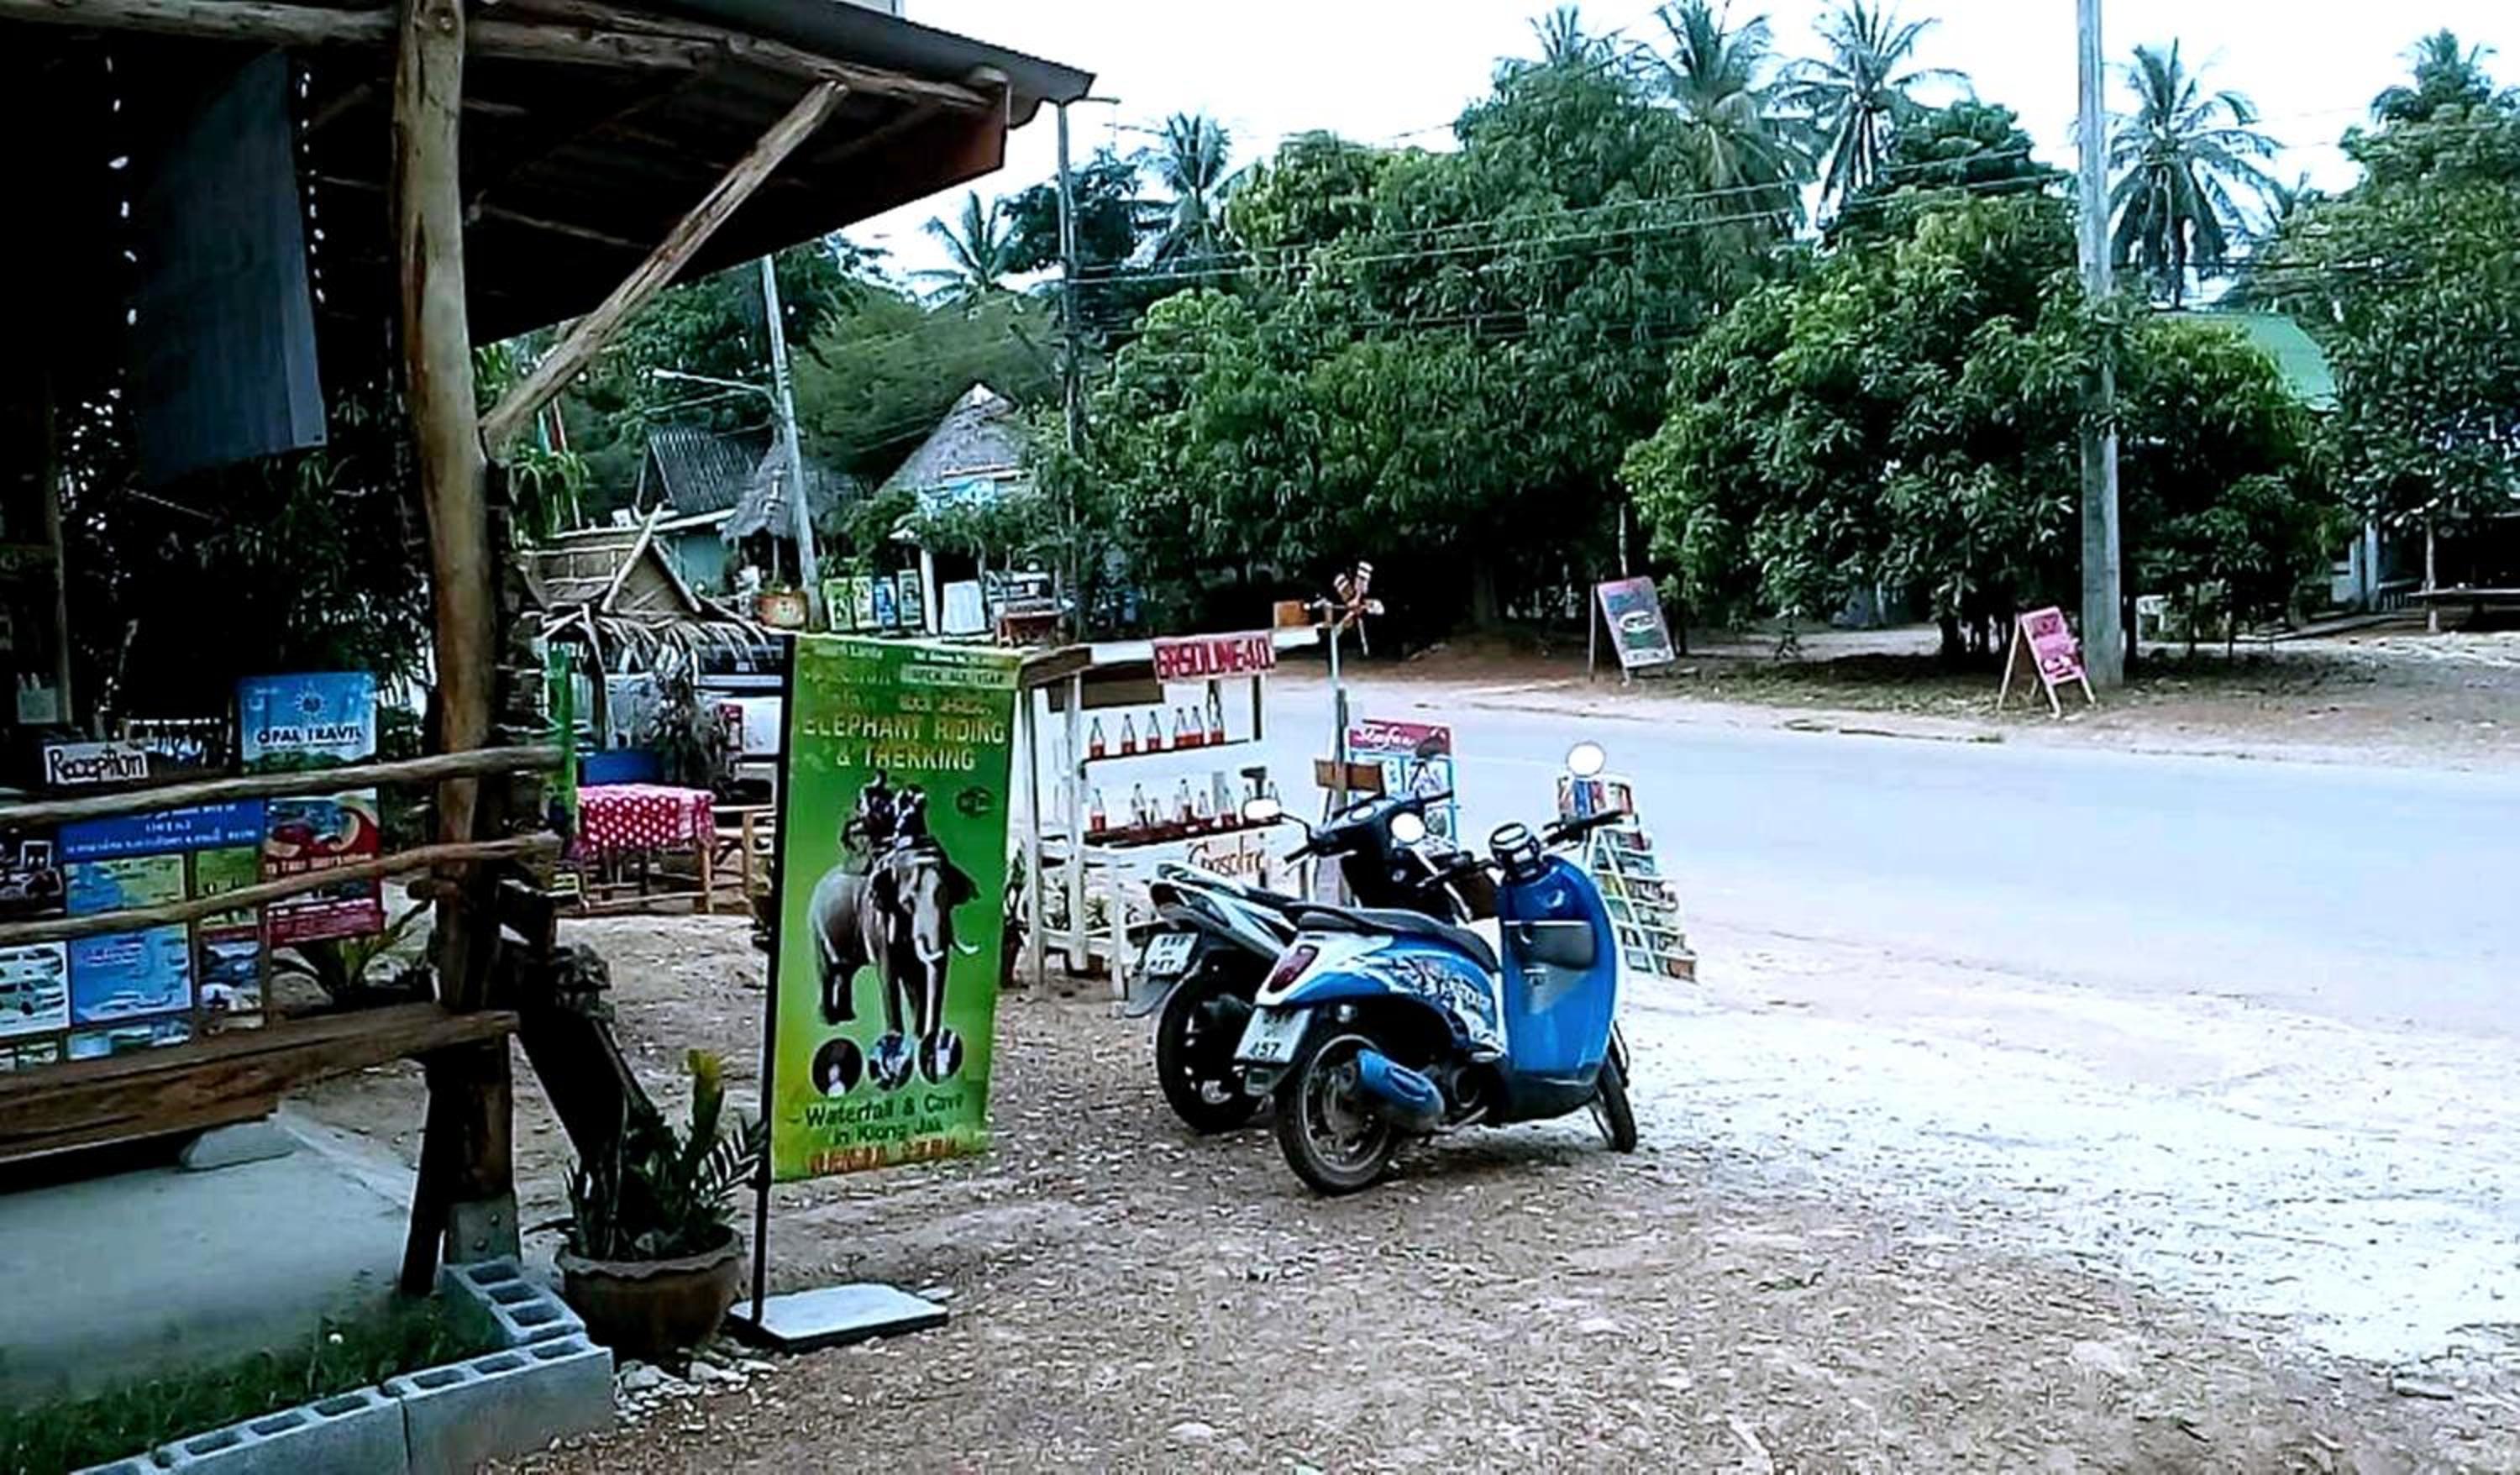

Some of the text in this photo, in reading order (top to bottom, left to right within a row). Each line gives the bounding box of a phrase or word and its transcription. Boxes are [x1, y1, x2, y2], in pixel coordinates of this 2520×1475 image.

[257, 727, 301, 744] OPAL
[803, 713, 1006, 744] ELEPHANT RIDING
[806, 1099, 894, 1127] Waterfall
[857, 1124, 907, 1142] Klong
